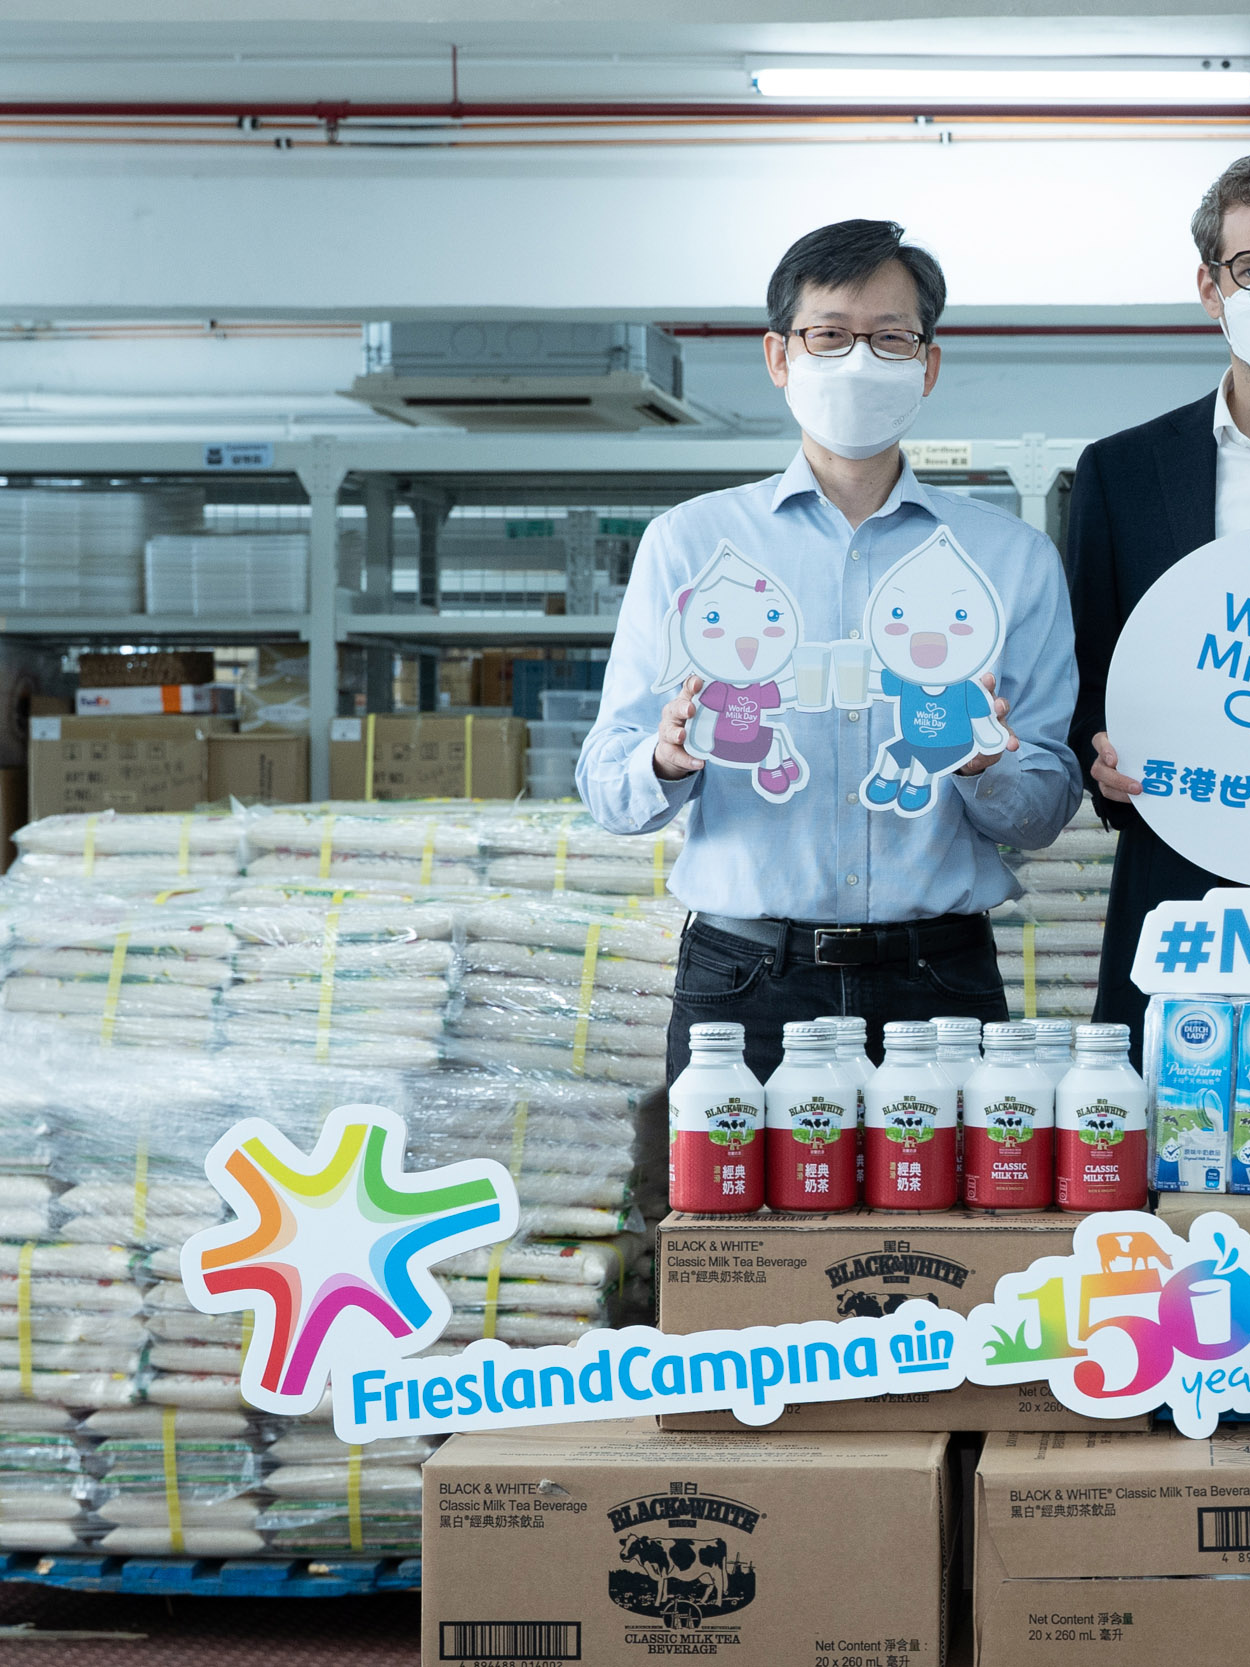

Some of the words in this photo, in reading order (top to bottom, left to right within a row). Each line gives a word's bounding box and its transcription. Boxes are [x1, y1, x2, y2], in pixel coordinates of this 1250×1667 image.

[728, 704, 751, 713] World
[916, 711, 938, 720] World
[1166, 1061, 1222, 1077] PureFarm
[722, 1164, 746, 1179] 經典
[805, 1163, 829, 1178] 經典
[897, 1162, 922, 1177] 經典
[992, 1162, 1027, 1171] CLASSIC
[1084, 1165, 1119, 1173] CLASSIC
[991, 1172, 1012, 1180] MILK
[1012, 1172, 1029, 1180] TEA
[1083, 1174, 1104, 1182] MILK
[1105, 1174, 1121, 1182] TEA
[722, 1180, 746, 1195] 奶茶
[805, 1179, 829, 1193] 奶茶
[897, 1177, 921, 1191] 奶茶
[667, 1240, 706, 1251] BLACK
[709, 1240, 717, 1251] &
[883, 1240, 910, 1253] 黑白
[667, 1256, 706, 1267] Classic
[709, 1256, 730, 1267] Milk
[733, 1256, 753, 1267] Tea
[756, 1256, 808, 1270] Beverage
[1019, 1386, 1032, 1398] Net
[1018, 1401, 1033, 1413] 20
[1034, 1403, 1042, 1412] x
[1044, 1401, 1063, 1413] 260
[439, 1483, 481, 1494] BLACK
[484, 1483, 492, 1494] &
[669, 1481, 698, 1495] 黑白
[1010, 1490, 1051, 1501] BLACK
[1054, 1489, 1064, 1501] &
[1115, 1487, 1157, 1499] Classic
[1159, 1486, 1183, 1498] Milk
[1185, 1486, 1207, 1497] Tea
[439, 1500, 480, 1511] Classic
[483, 1500, 506, 1511] Milk
[508, 1500, 530, 1511] Tea
[534, 1500, 588, 1514] Beverage
[1221, 1553, 1229, 1563] 4
[1028, 1614, 1048, 1625] Net
[1051, 1614, 1094, 1625] Content
[1097, 1612, 1133, 1626] 淨含量
[624, 1634, 678, 1644] CLASSIC
[680, 1634, 714, 1644] MILK
[716, 1634, 741, 1644] TEA
[1028, 1630, 1042, 1641] 20
[1045, 1632, 1052, 1641] x
[1055, 1630, 1076, 1641] 260
[1079, 1630, 1096, 1641] mL
[1099, 1628, 1123, 1641] 毫升
[648, 1644, 718, 1655] BEVERAGE
[815, 1640, 835, 1651] Net
[838, 1640, 881, 1652] Content
[815, 1656, 829, 1667] 20
[832, 1659, 839, 1667] x
[842, 1656, 863, 1667] 260
[866, 1656, 883, 1667] mL
[886, 1654, 911, 1667] 毫升
